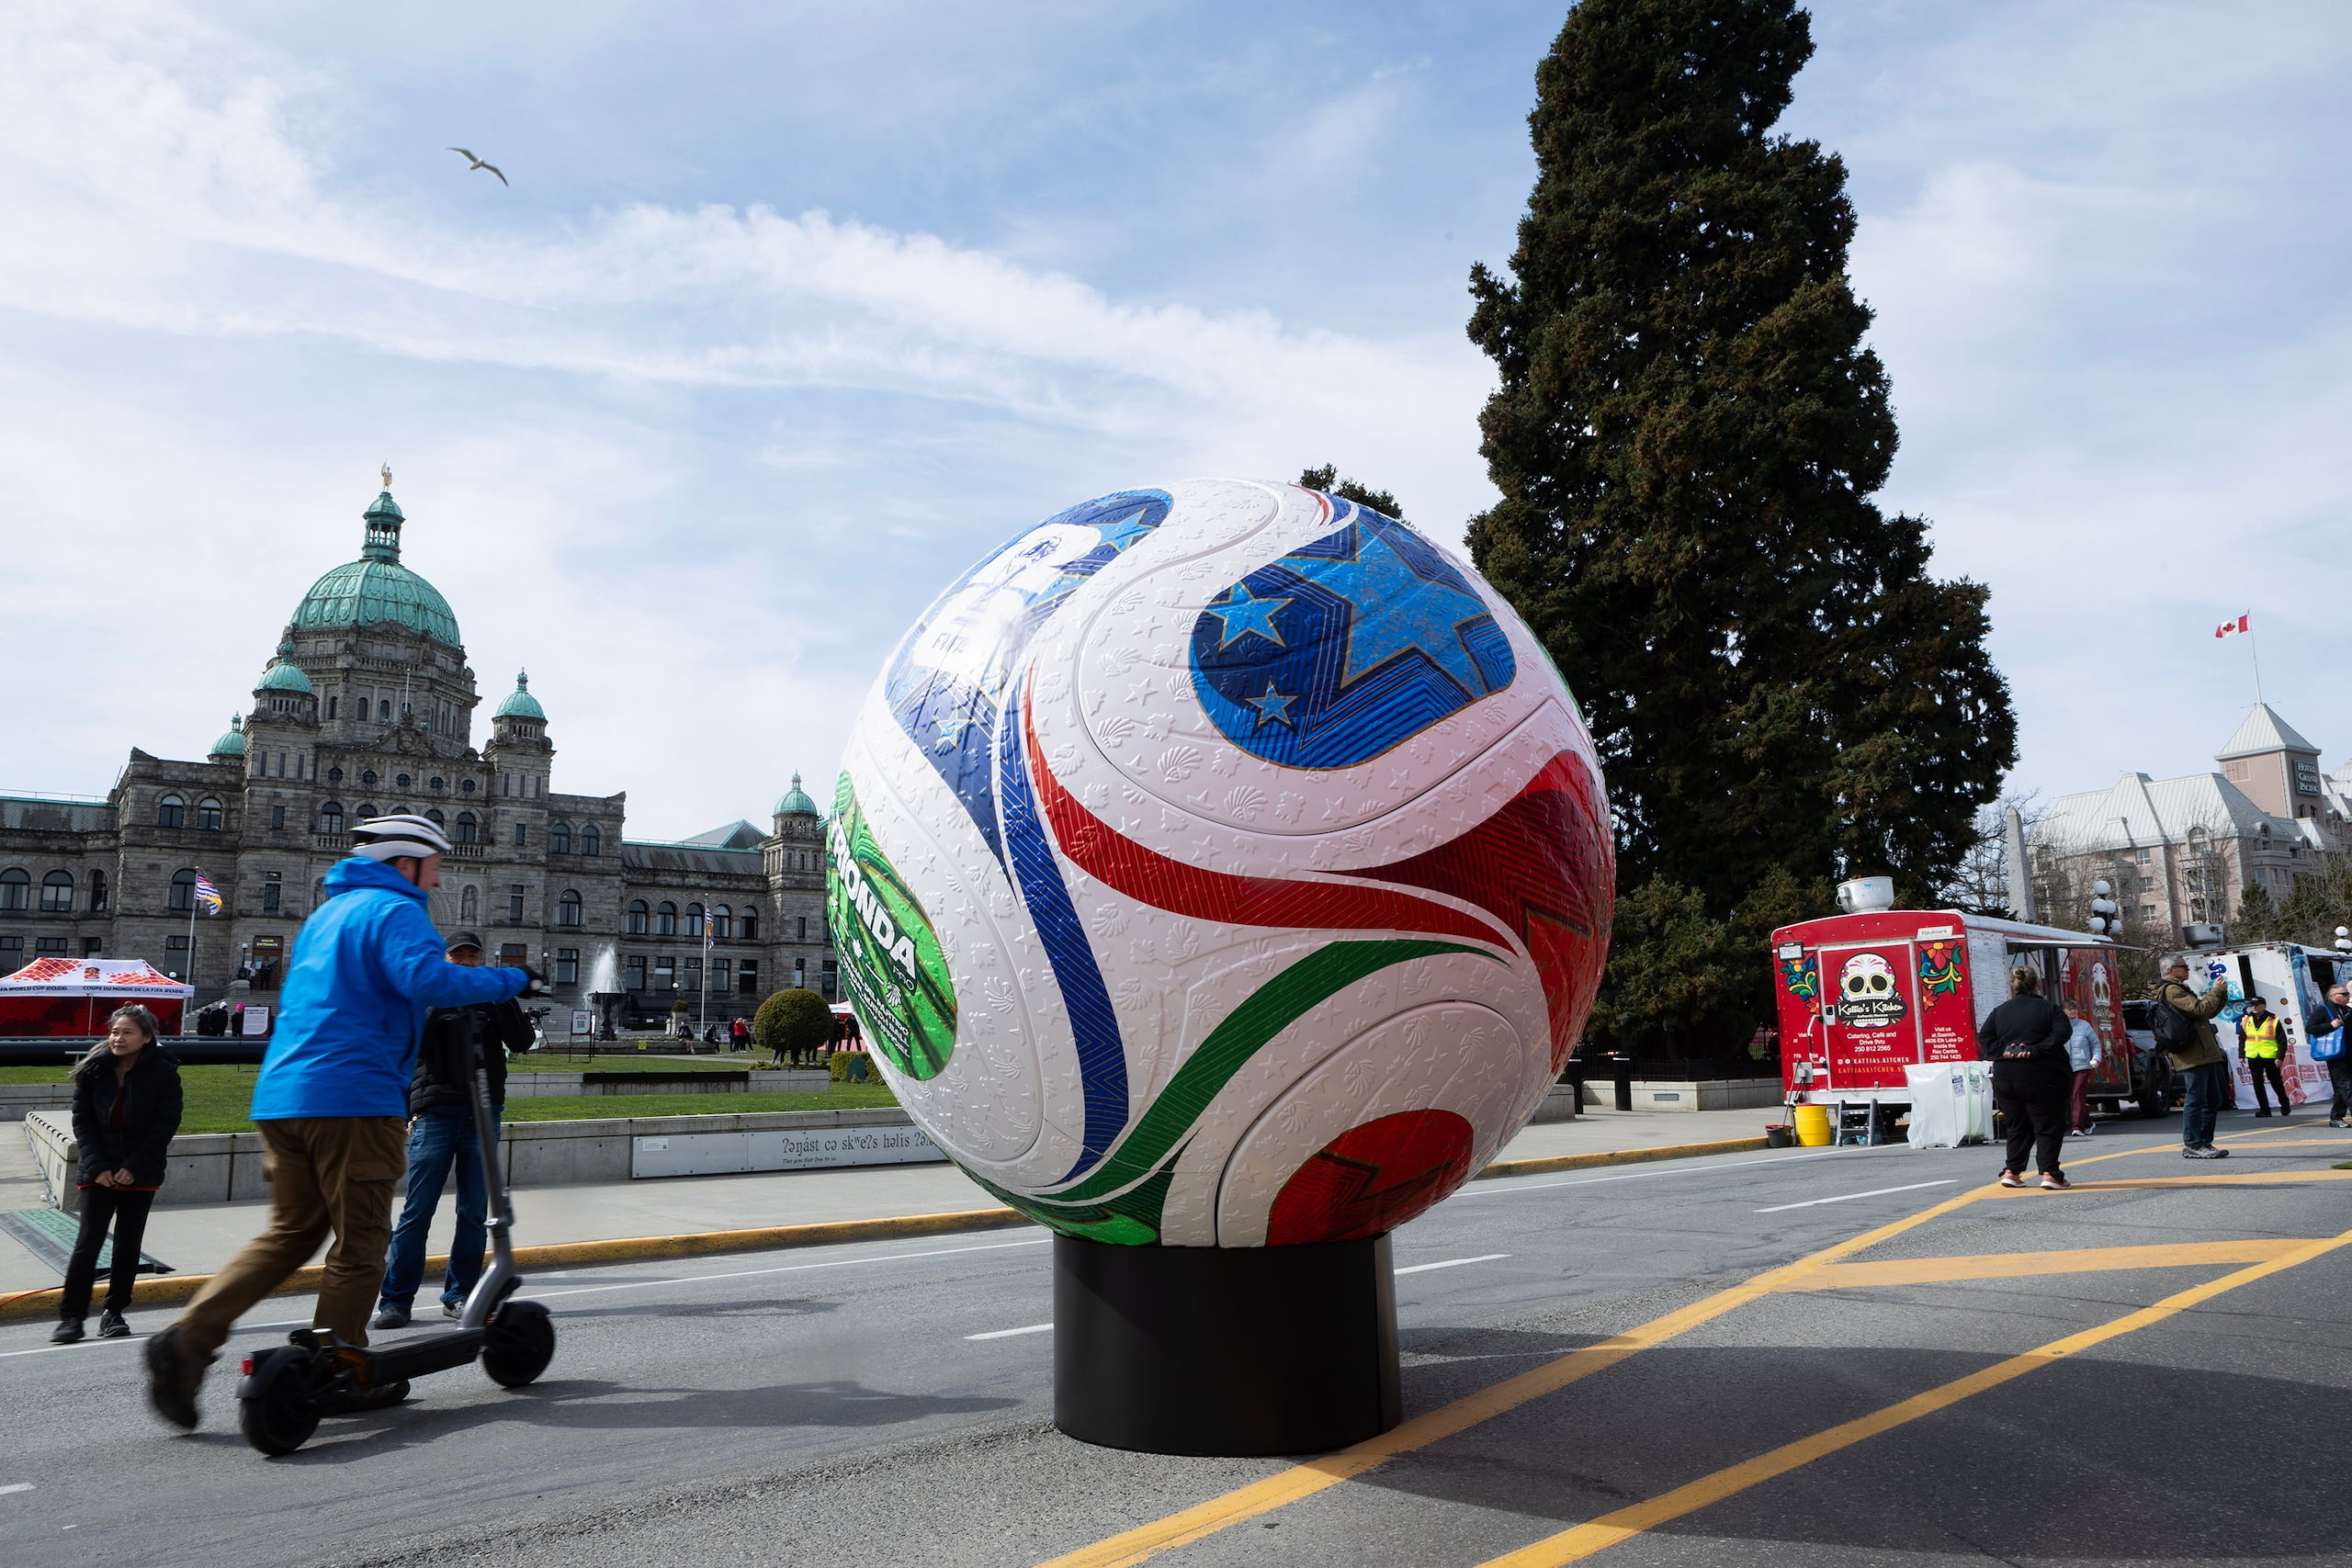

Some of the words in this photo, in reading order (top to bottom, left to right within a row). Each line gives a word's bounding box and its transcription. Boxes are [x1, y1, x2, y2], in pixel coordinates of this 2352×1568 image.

[892, 965, 915, 991] PRO
[876, 998, 910, 1037] PARTIDO
[1838, 1003, 1871, 1016] Kattia's
[1872, 1001, 1904, 1014] Kitchen
[888, 1021, 910, 1048] BALL
